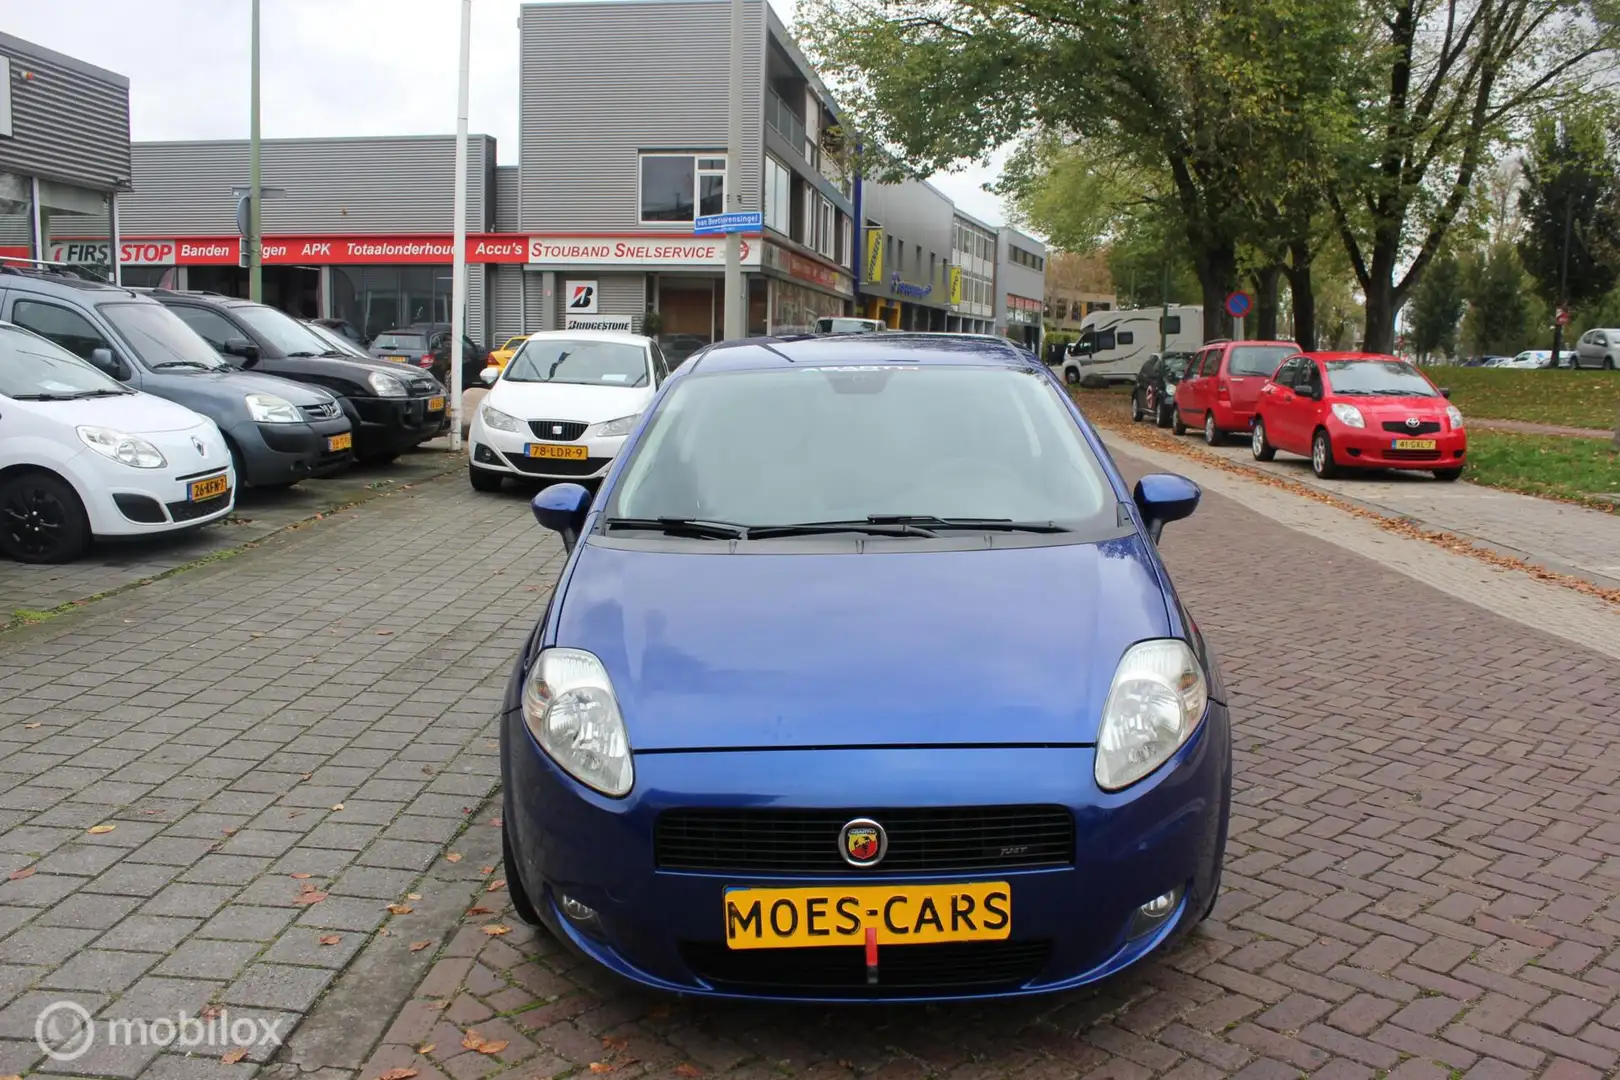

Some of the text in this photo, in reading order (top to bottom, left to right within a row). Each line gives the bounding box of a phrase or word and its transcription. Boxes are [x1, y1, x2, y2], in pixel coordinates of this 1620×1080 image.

[67, 244, 172, 262] FIRS STOP
[181, 244, 229, 257] Banden
[260, 243, 287, 259] lgen
[301, 243, 331, 256] APK
[475, 242, 523, 255] Accu's
[531, 242, 716, 259] STOUBAND SNELSERVICE
[567, 320, 630, 331] BRIDGESTONE
[531, 446, 583, 458] 78-LDR-9
[727, 891, 1010, 939] MOES-CARS
